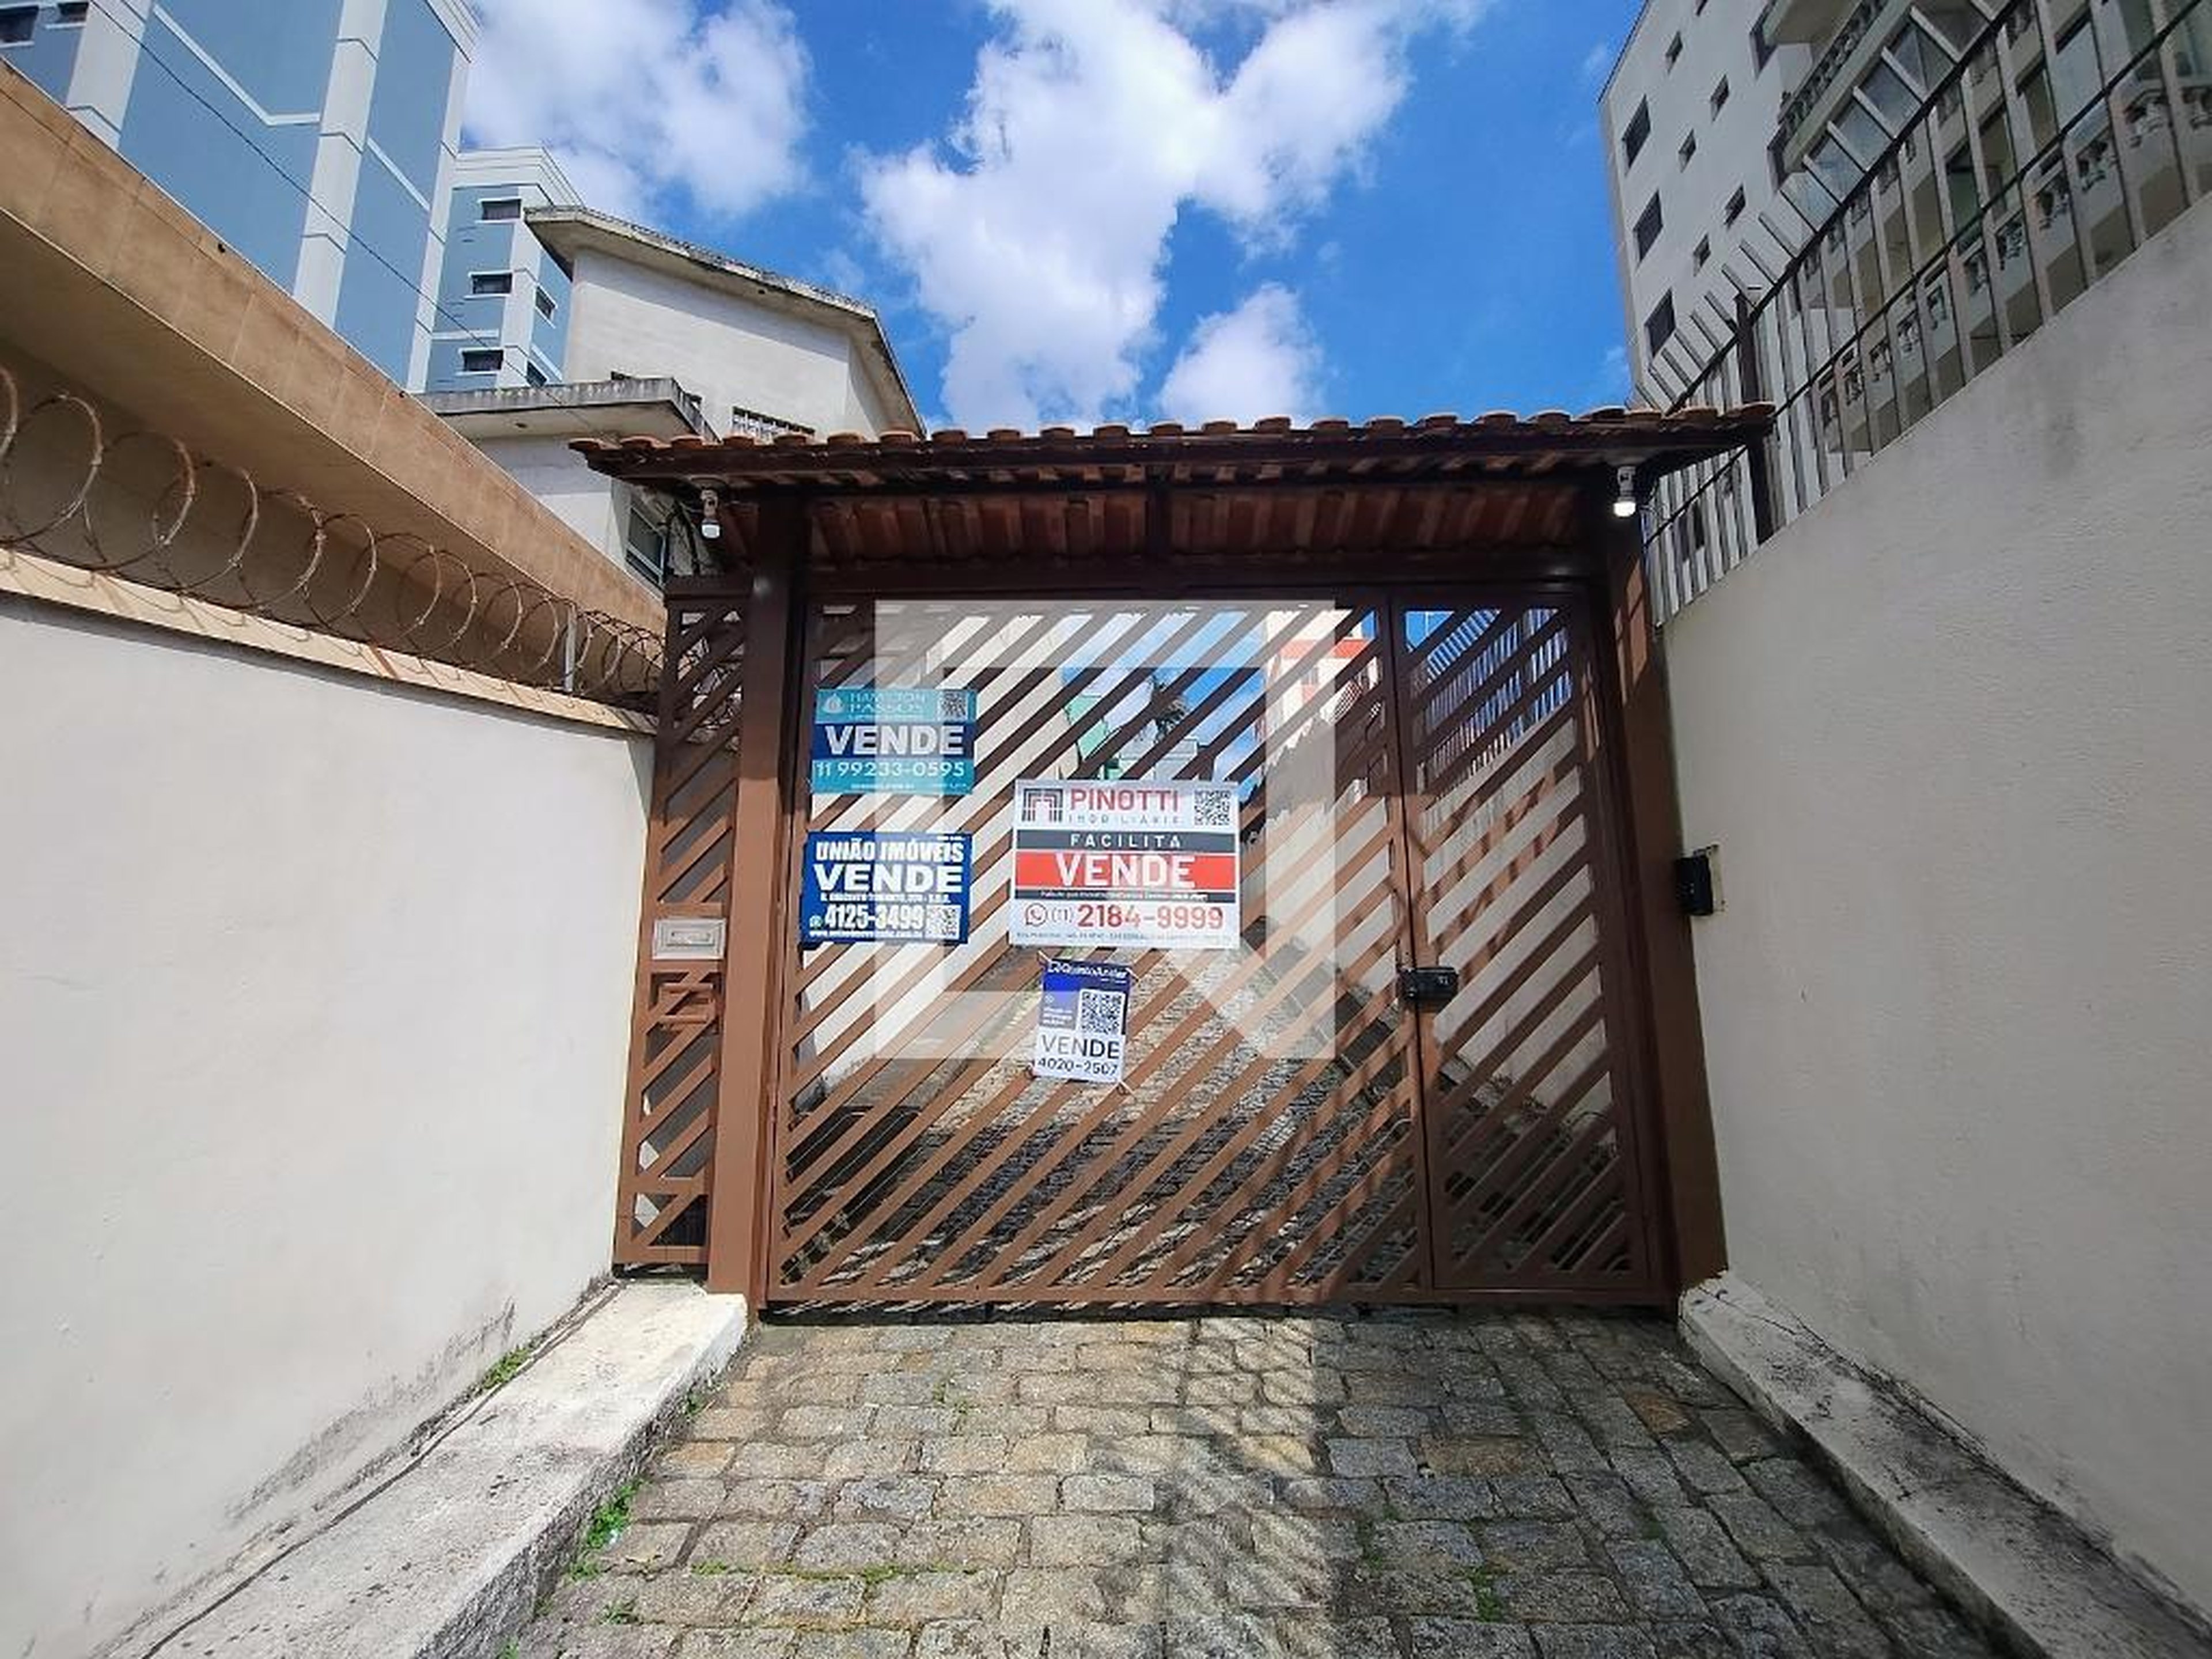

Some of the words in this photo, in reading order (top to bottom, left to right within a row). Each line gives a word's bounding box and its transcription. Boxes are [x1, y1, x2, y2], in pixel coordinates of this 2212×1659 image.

[824, 725, 964, 755] VENDE
[837, 762, 965, 777] 99233-0595
[1070, 788, 1179, 811] PINOTTI
[816, 838, 875, 861] UNIÃO
[881, 839, 964, 862] IMÓVEIS
[1070, 834, 1181, 849] FACILITA
[814, 864, 964, 892] VENDE
[1055, 853, 1196, 889] VENDE
[824, 904, 925, 930] 4125-3499
[1077, 904, 1224, 930] 2184-9999
[1041, 1034, 1120, 1059] VENDE
